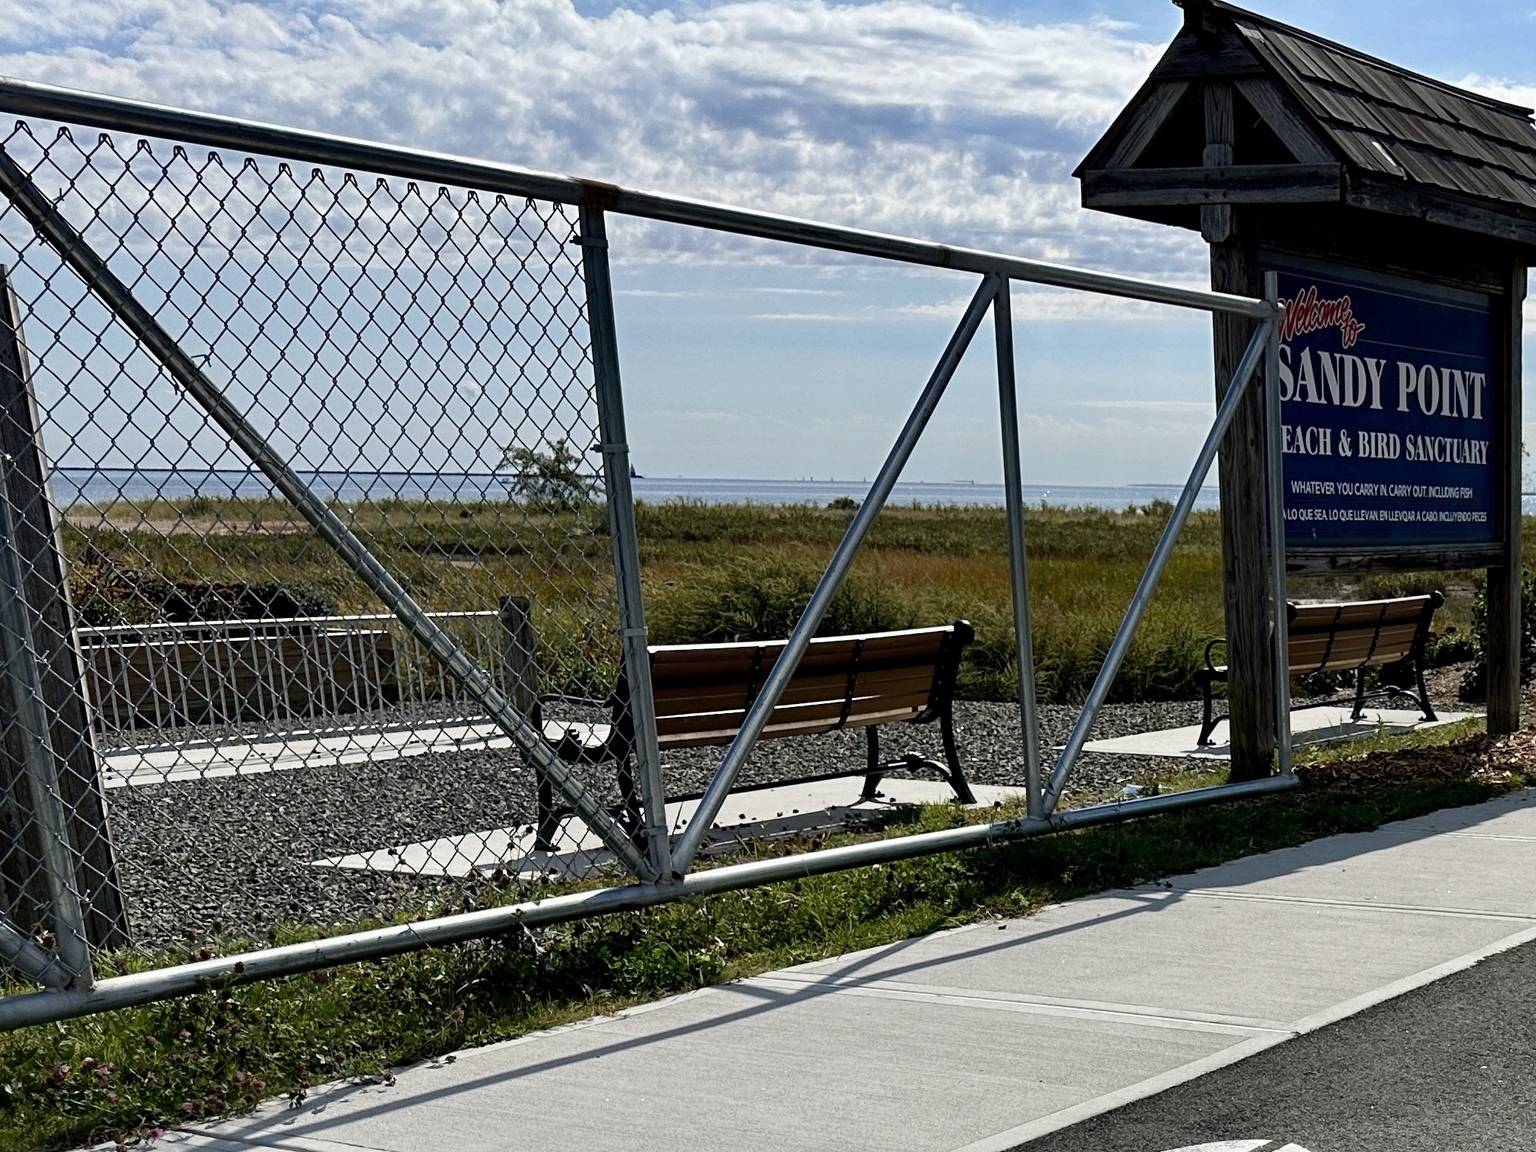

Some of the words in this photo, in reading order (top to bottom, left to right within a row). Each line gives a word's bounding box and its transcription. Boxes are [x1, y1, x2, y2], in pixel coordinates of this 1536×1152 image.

[1277, 285, 1352, 343] Welcome
[1341, 311, 1366, 349] to
[1279, 344, 1387, 410] SANDY
[1396, 360, 1486, 420] POINT
[1281, 425, 1332, 456] EACH
[1338, 429, 1353, 457] &
[1358, 431, 1401, 460] BIRD
[1405, 434, 1489, 465] SANCTUARY
[1290, 480, 1335, 495] WHATEVER
[1336, 482, 1354, 496] YOU
[1354, 483, 1379, 496] CARRY
[1388, 484, 1412, 498] CARRY
[1428, 486, 1460, 499] INCLUDING
[1460, 487, 1473, 499] FISH
[1287, 509, 1298, 520] LO
[1298, 509, 1313, 522] QUE
[1328, 509, 1339, 521] LO
[1339, 509, 1354, 522] QUE
[1379, 510, 1388, 521] EN
[1416, 511, 1421, 521] A
[1471, 512, 1488, 522] PECES
